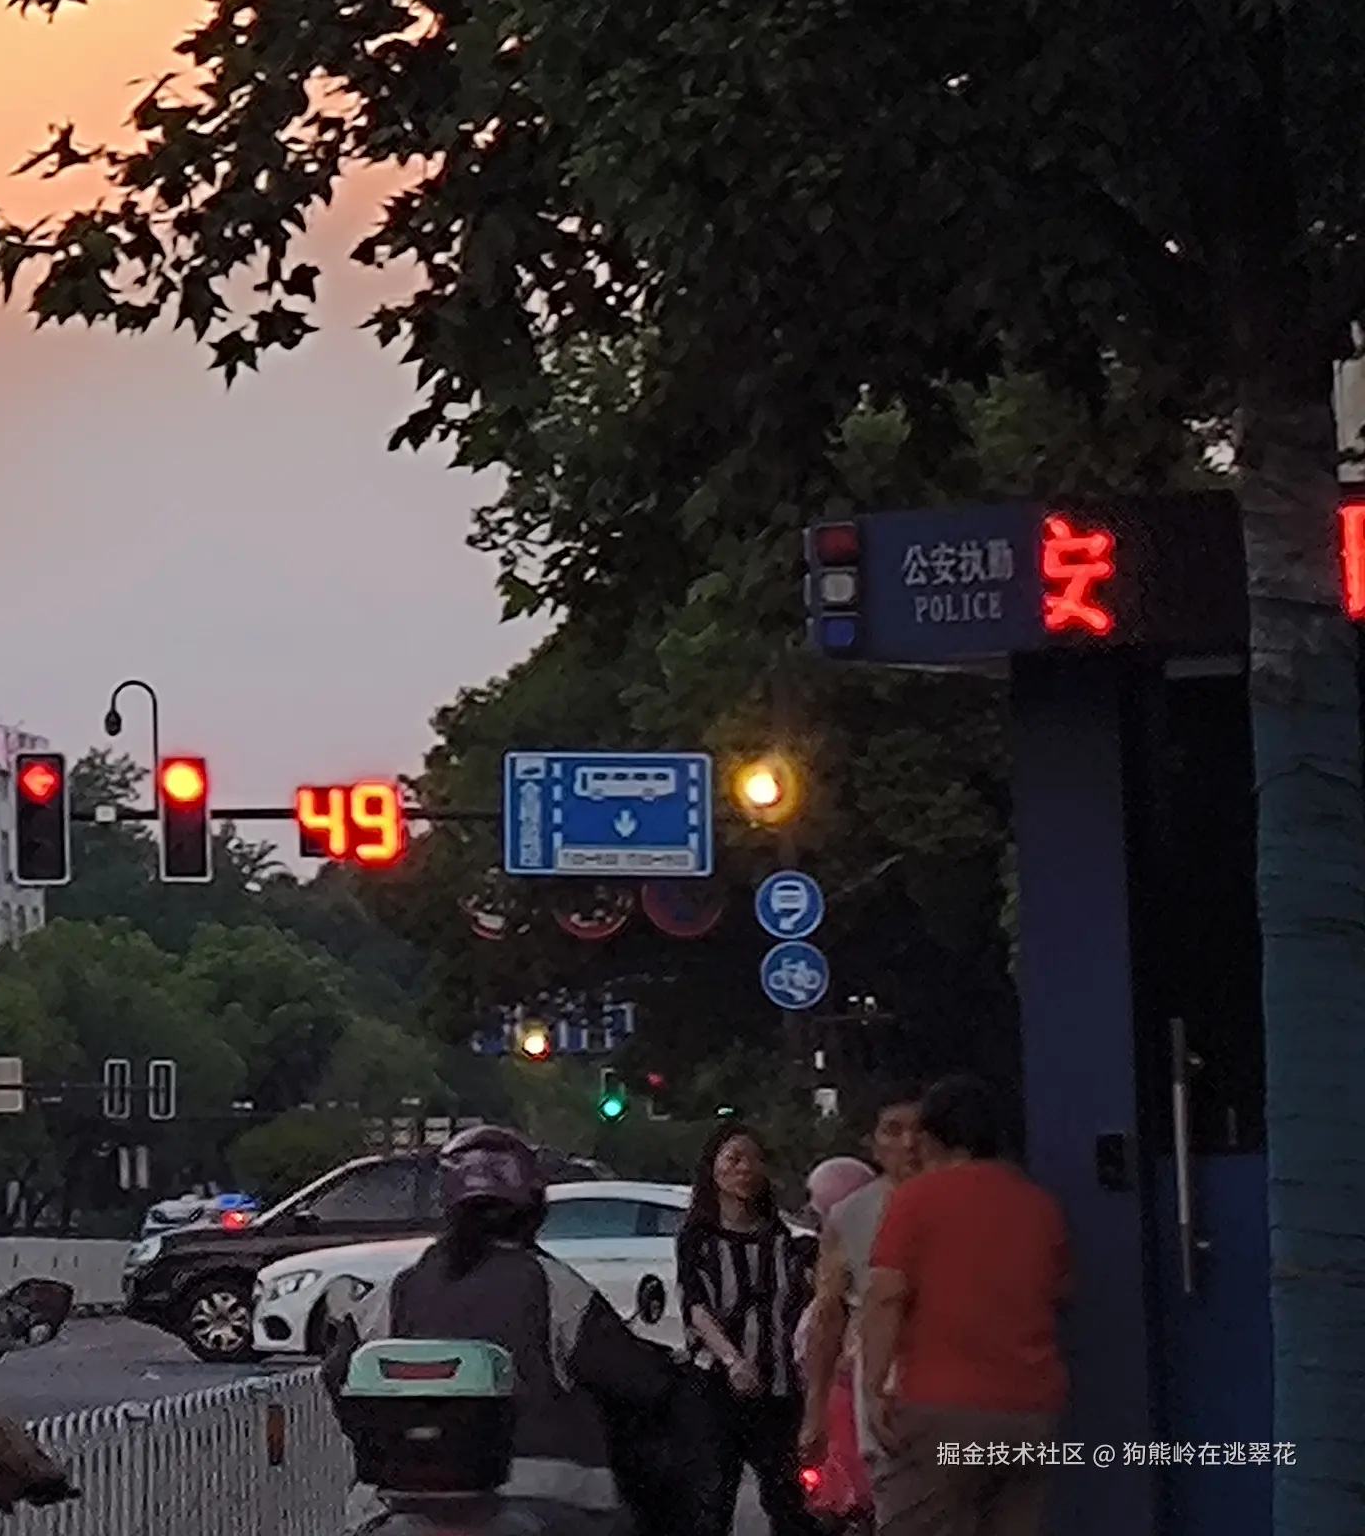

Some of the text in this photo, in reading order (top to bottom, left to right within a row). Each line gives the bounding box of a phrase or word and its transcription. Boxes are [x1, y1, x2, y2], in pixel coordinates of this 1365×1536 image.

[902, 541, 1013, 587] 公安执勤
[1042, 516, 1114, 634] 安
[916, 592, 1002, 622] POLICE
[296, 783, 401, 861] 49
